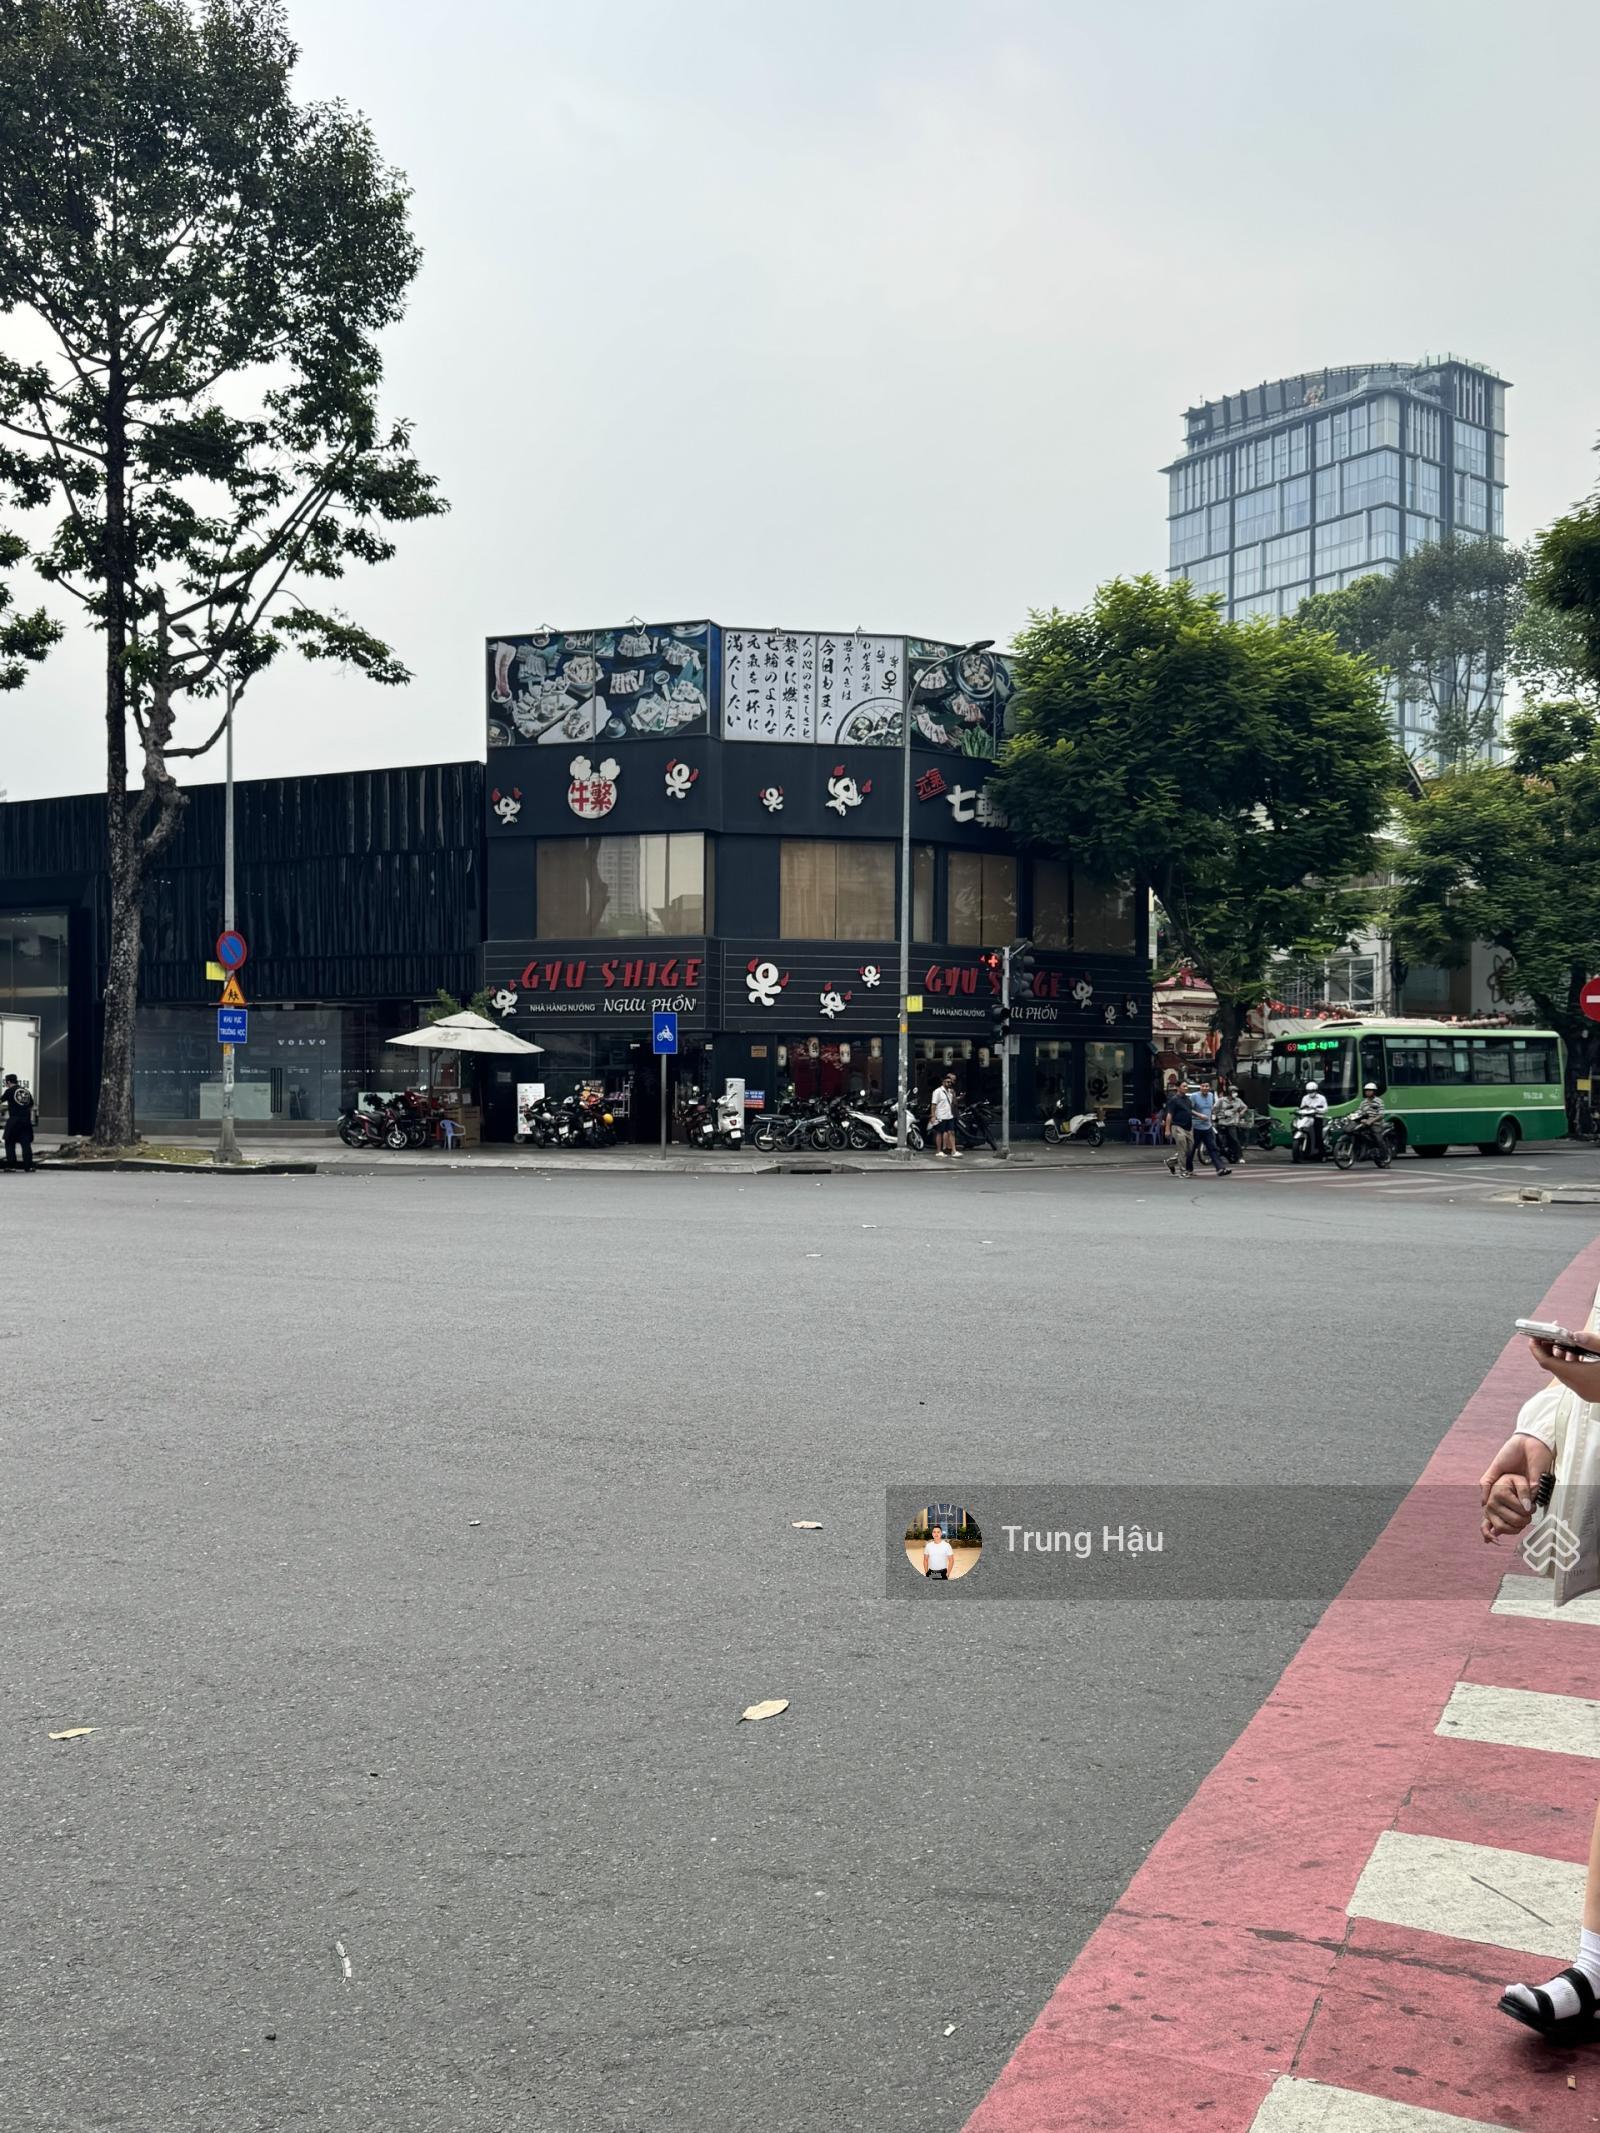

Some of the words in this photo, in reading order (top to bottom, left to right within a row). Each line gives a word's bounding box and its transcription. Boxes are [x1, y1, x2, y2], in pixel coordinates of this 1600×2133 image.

[571, 782, 612, 811] 牛繁
[521, 960, 586, 991] GYU
[601, 959, 703, 988] SHIGE
[925, 964, 979, 996] GYU
[1287, 1042, 1297, 1052] 69
